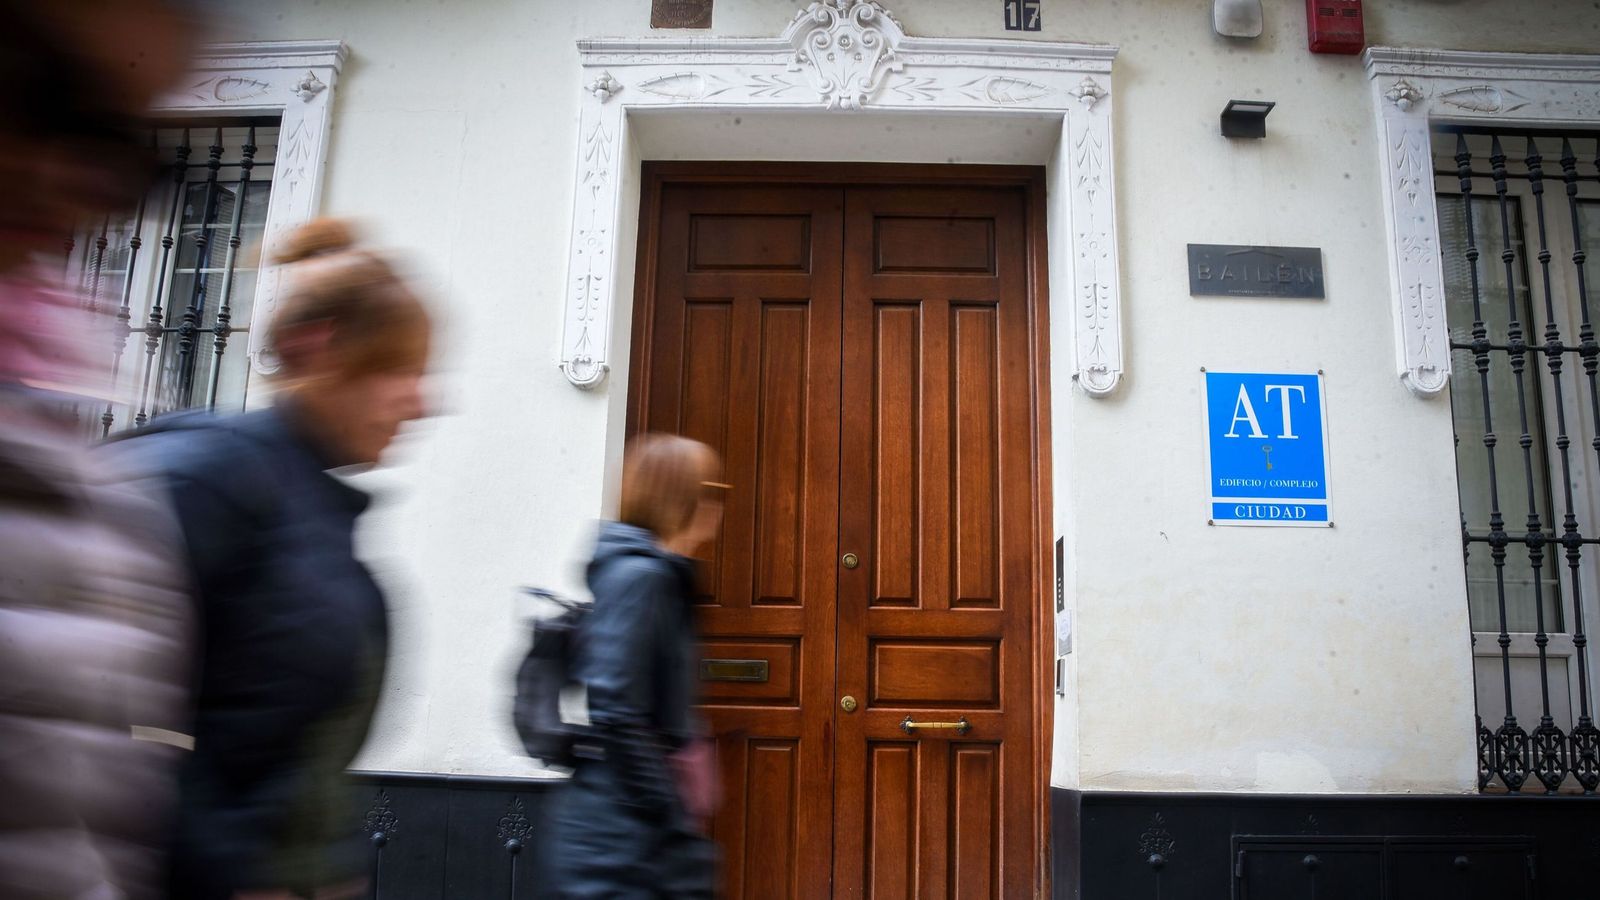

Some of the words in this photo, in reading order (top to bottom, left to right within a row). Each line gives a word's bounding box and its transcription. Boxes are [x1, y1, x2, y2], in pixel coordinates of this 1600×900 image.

[1005, 1, 1040, 28] 17
[1223, 383, 1306, 439] AT
[1219, 478, 1262, 487] EDIFICIO
[1269, 479, 1319, 488] COMPLEJO
[1234, 505, 1307, 519] CIUDAD
